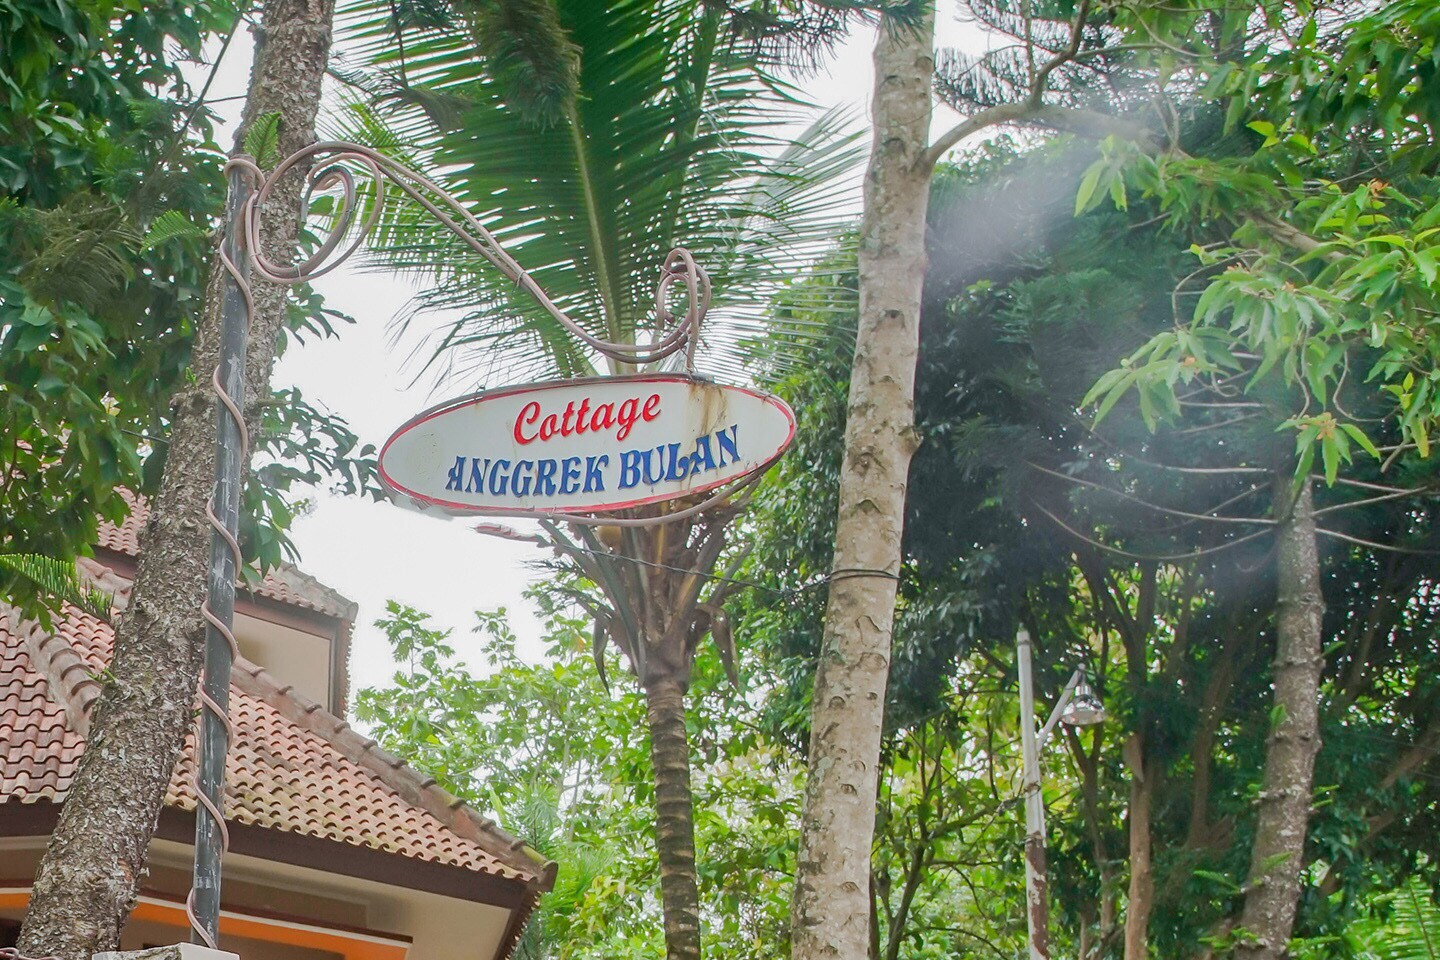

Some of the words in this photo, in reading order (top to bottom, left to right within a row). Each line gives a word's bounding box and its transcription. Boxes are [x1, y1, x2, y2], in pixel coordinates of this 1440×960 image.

[514, 393, 661, 445] Cottage
[446, 454, 609, 497] ANGGREK
[617, 424, 741, 491] BULAN
